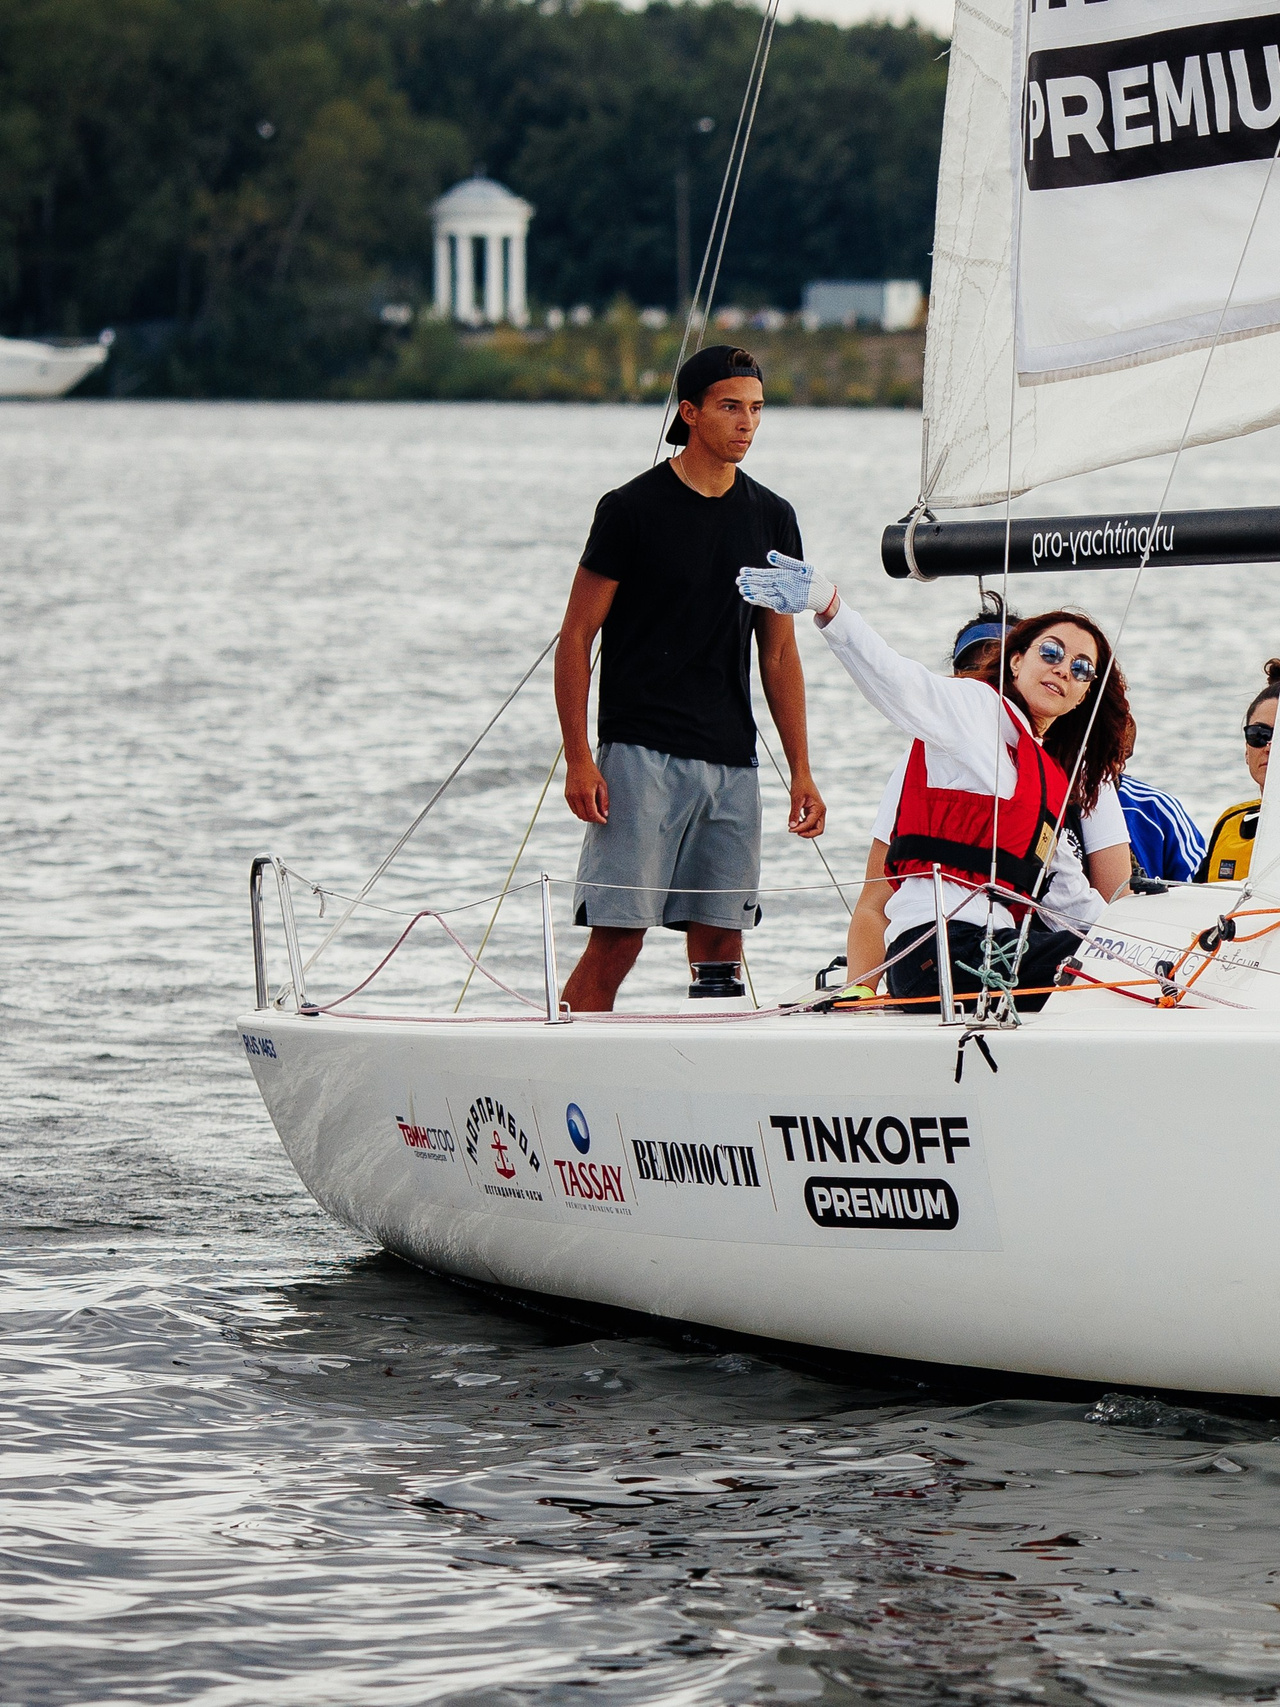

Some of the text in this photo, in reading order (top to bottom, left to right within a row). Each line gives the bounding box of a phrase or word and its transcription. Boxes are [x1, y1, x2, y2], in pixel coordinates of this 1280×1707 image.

[1032, 520, 1175, 565] pro-yachting.ru
[466, 1096, 540, 1173] МОРПРИБОР
[769, 1115, 970, 1165] TINKOFF
[553, 1160, 625, 1202] TASSAY
[631, 1138, 761, 1188] ВЕДОМОСТИ
[614, 1207, 632, 1216] WATER
[811, 1185, 949, 1219] PREMIUM
